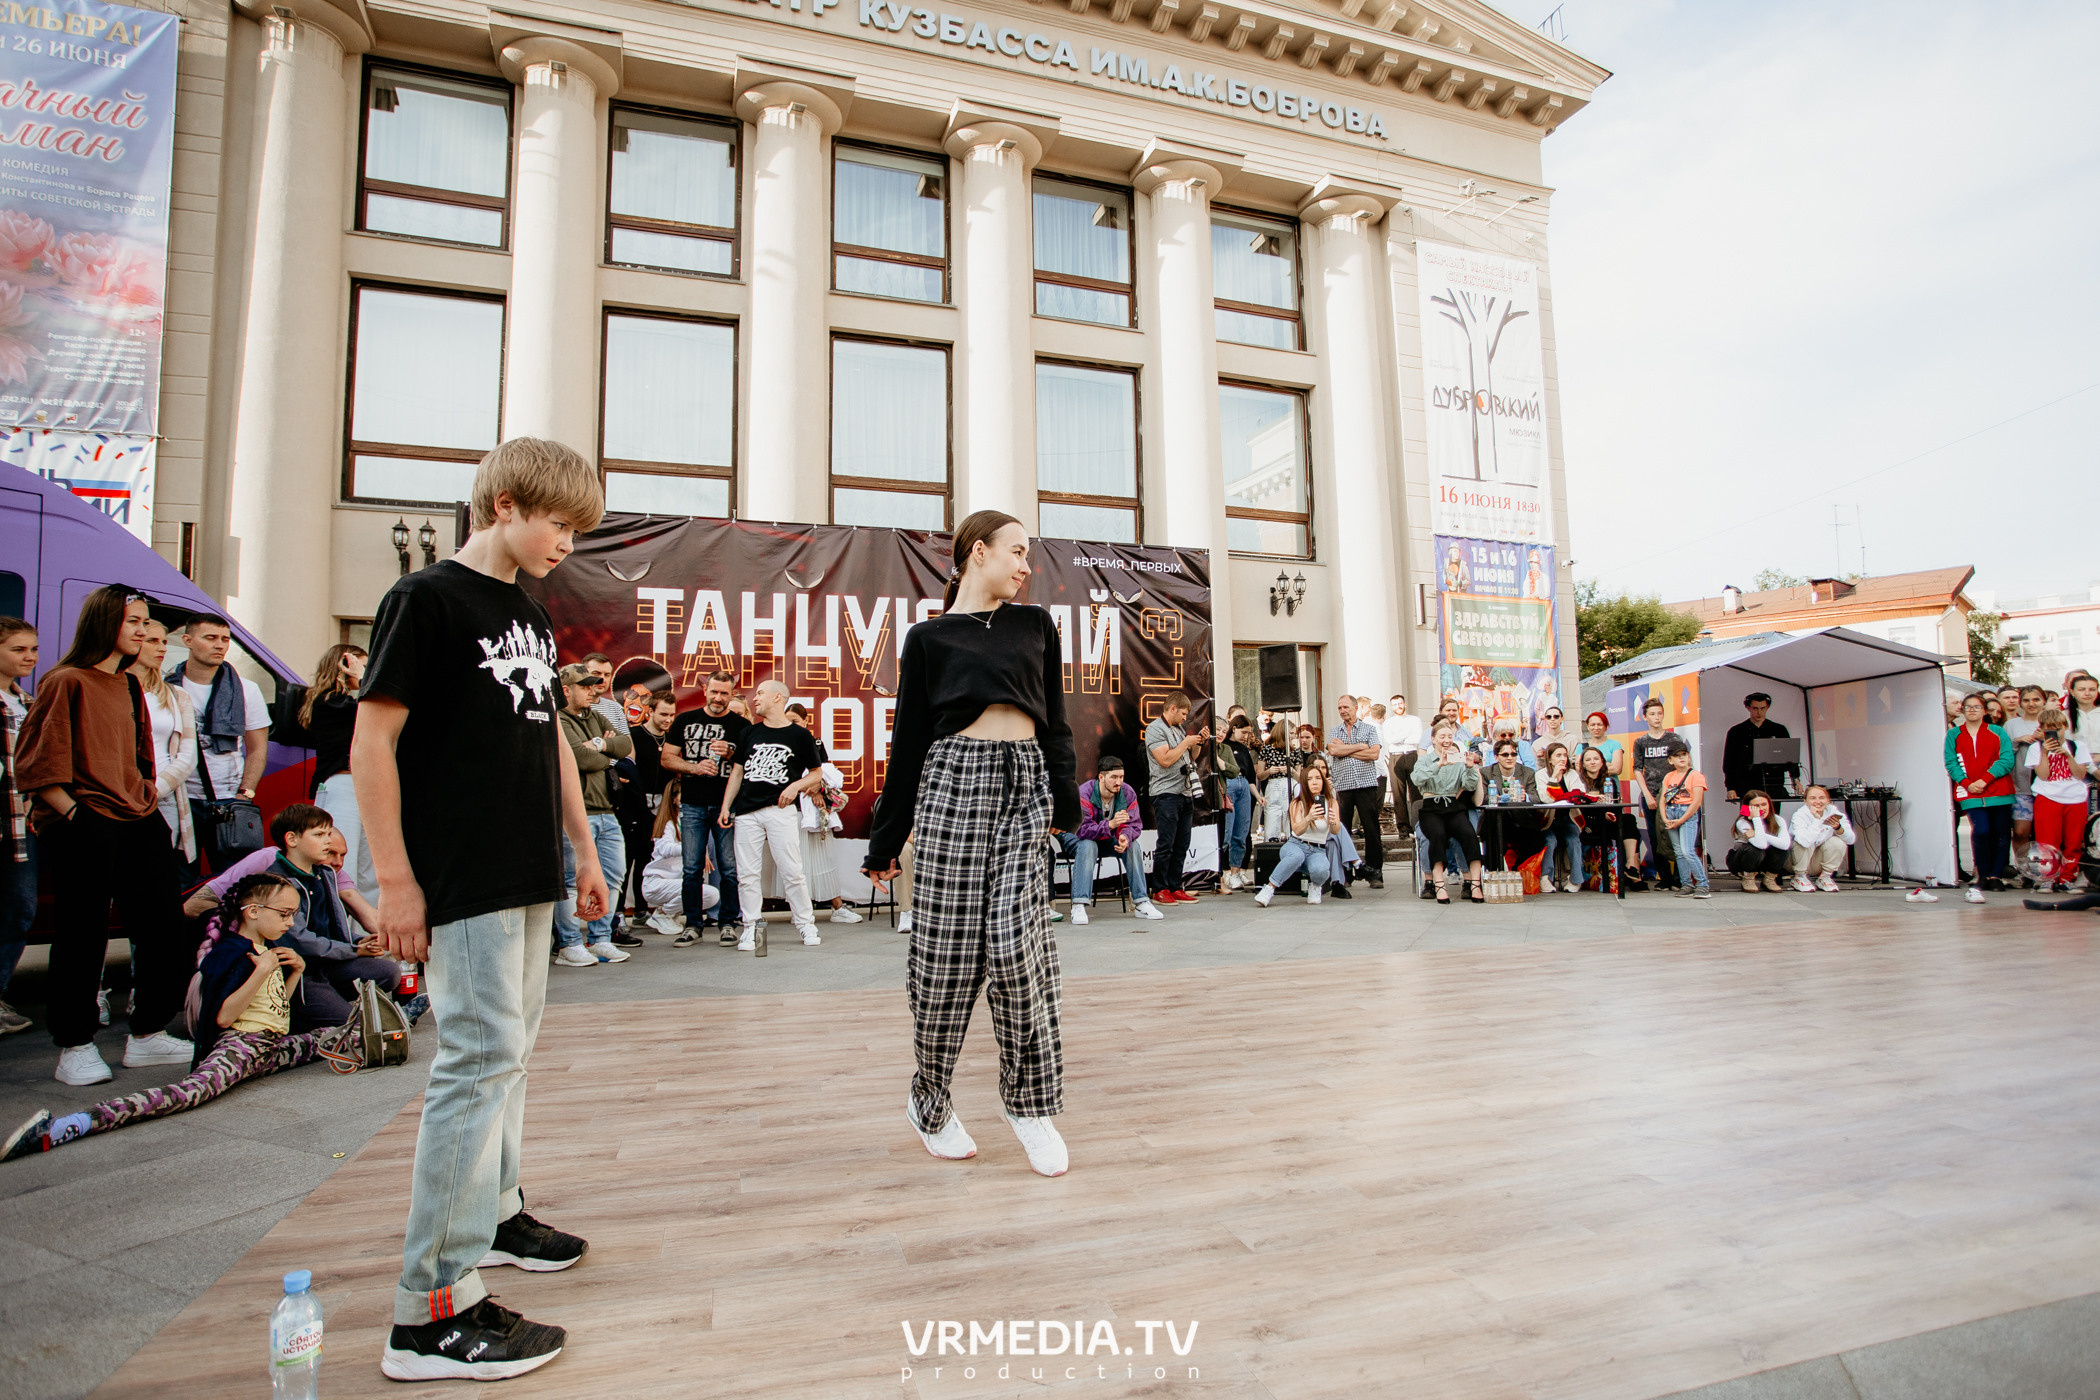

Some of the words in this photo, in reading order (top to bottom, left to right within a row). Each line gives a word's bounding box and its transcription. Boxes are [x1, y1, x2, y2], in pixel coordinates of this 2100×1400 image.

[859, 0, 1078, 71] КУЗБАССА
[12, 34, 42, 55] 26
[48, 39, 128, 69] ИЮНЯ
[2, 157, 69, 177] КОМЕДИЯ
[86, 185, 121, 199] Бориса
[30, 190, 101, 211] СОВЕТСКОЙ
[103, 202, 156, 218] ЭСТРАДЫ
[1433, 385, 1541, 422] ДУБРОВСКИЙ
[1509, 427, 1541, 440] МЮЗИКЛ
[1439, 485, 1458, 505] 16
[1463, 492, 1511, 510] ИЮНЯ
[1516, 500, 1541, 514] 18:30
[1073, 556, 1182, 574] #ВРЕМЯ_ПЕРВЫХ
[1471, 546, 1488, 564] 15
[1501, 549, 1518, 566] 16
[1454, 610, 1544, 634] ЗДРАВСТВУЙ,
[1452, 629, 1546, 650] СВЕТОФОРИК!
[1644, 745, 1669, 758] LEADE
[438, 1330, 462, 1350] FILA
[466, 1341, 489, 1362] FILA
